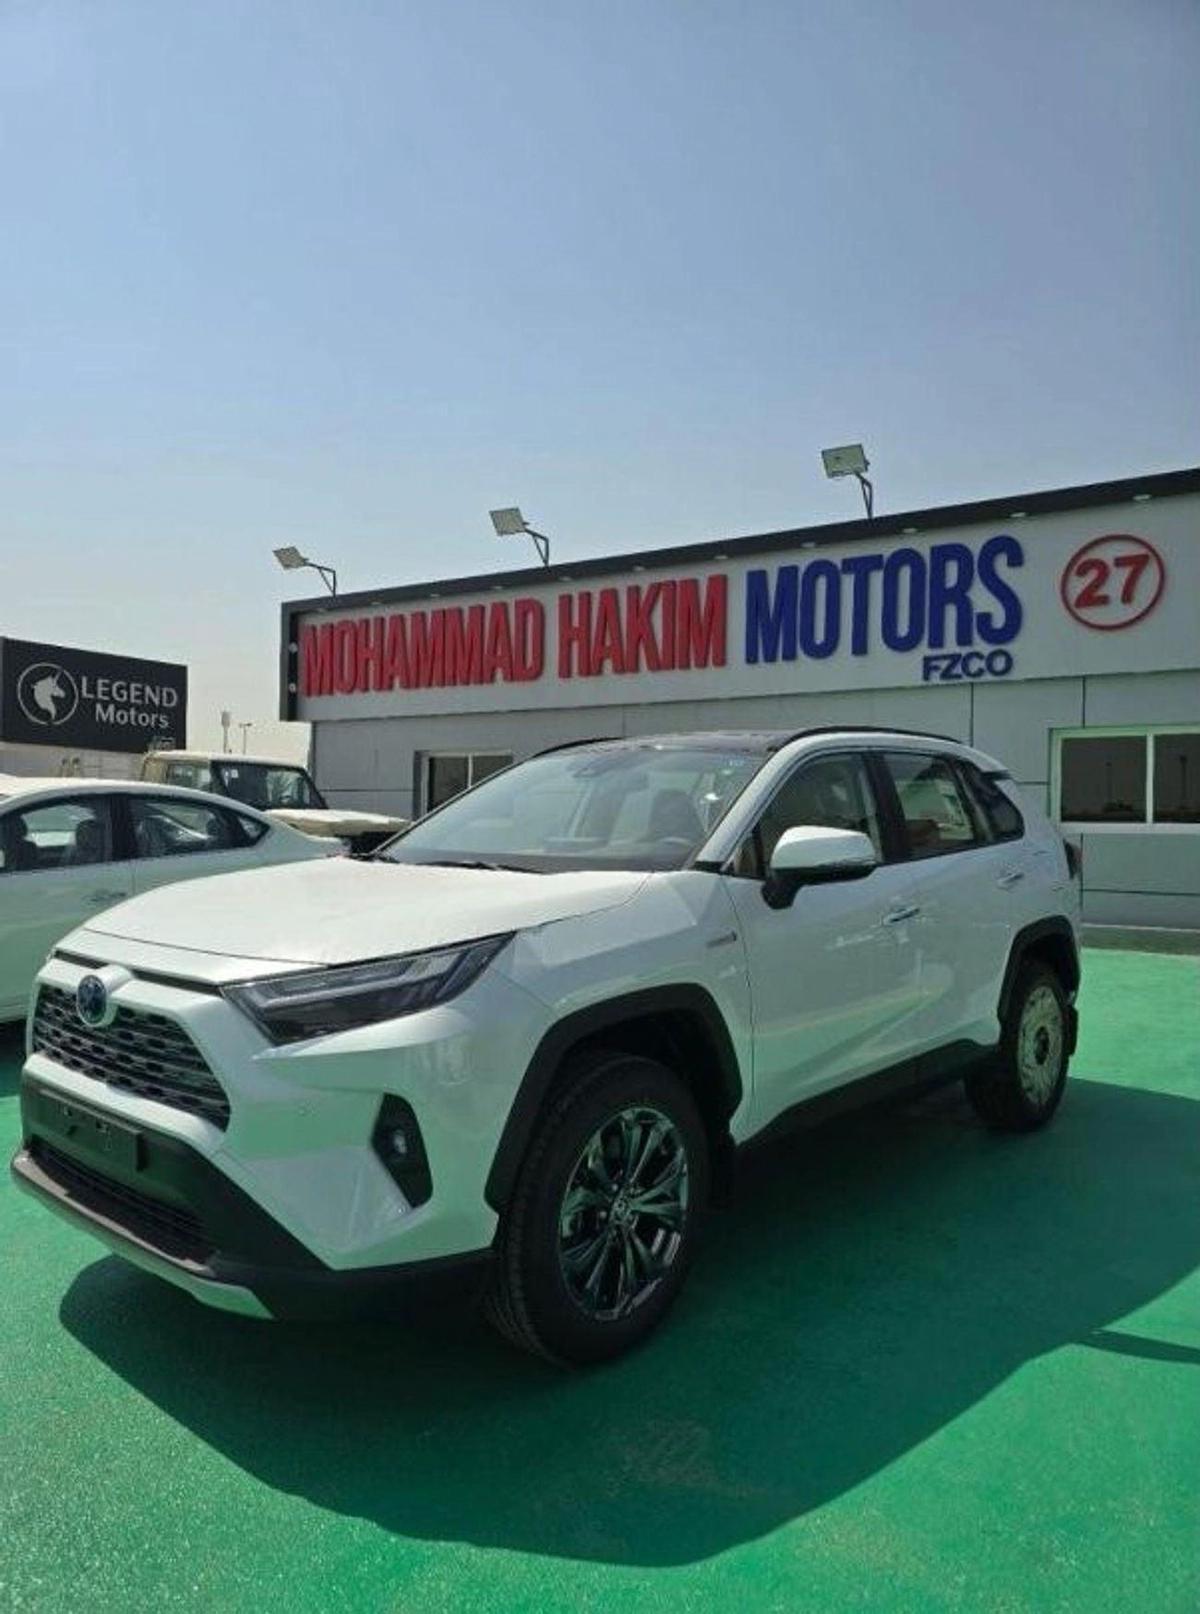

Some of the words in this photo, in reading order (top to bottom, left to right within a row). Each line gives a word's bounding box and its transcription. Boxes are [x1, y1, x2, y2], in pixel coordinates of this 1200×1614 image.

[1074, 553, 1150, 609] 27
[304, 598, 546, 697] MOHAMMAD
[558, 574, 728, 678] HAKIM
[745, 535, 1024, 665] MOTORS
[922, 649, 1013, 682] FZCO
[80, 675, 178, 708] LEGEND
[95, 703, 169, 729] Motors
